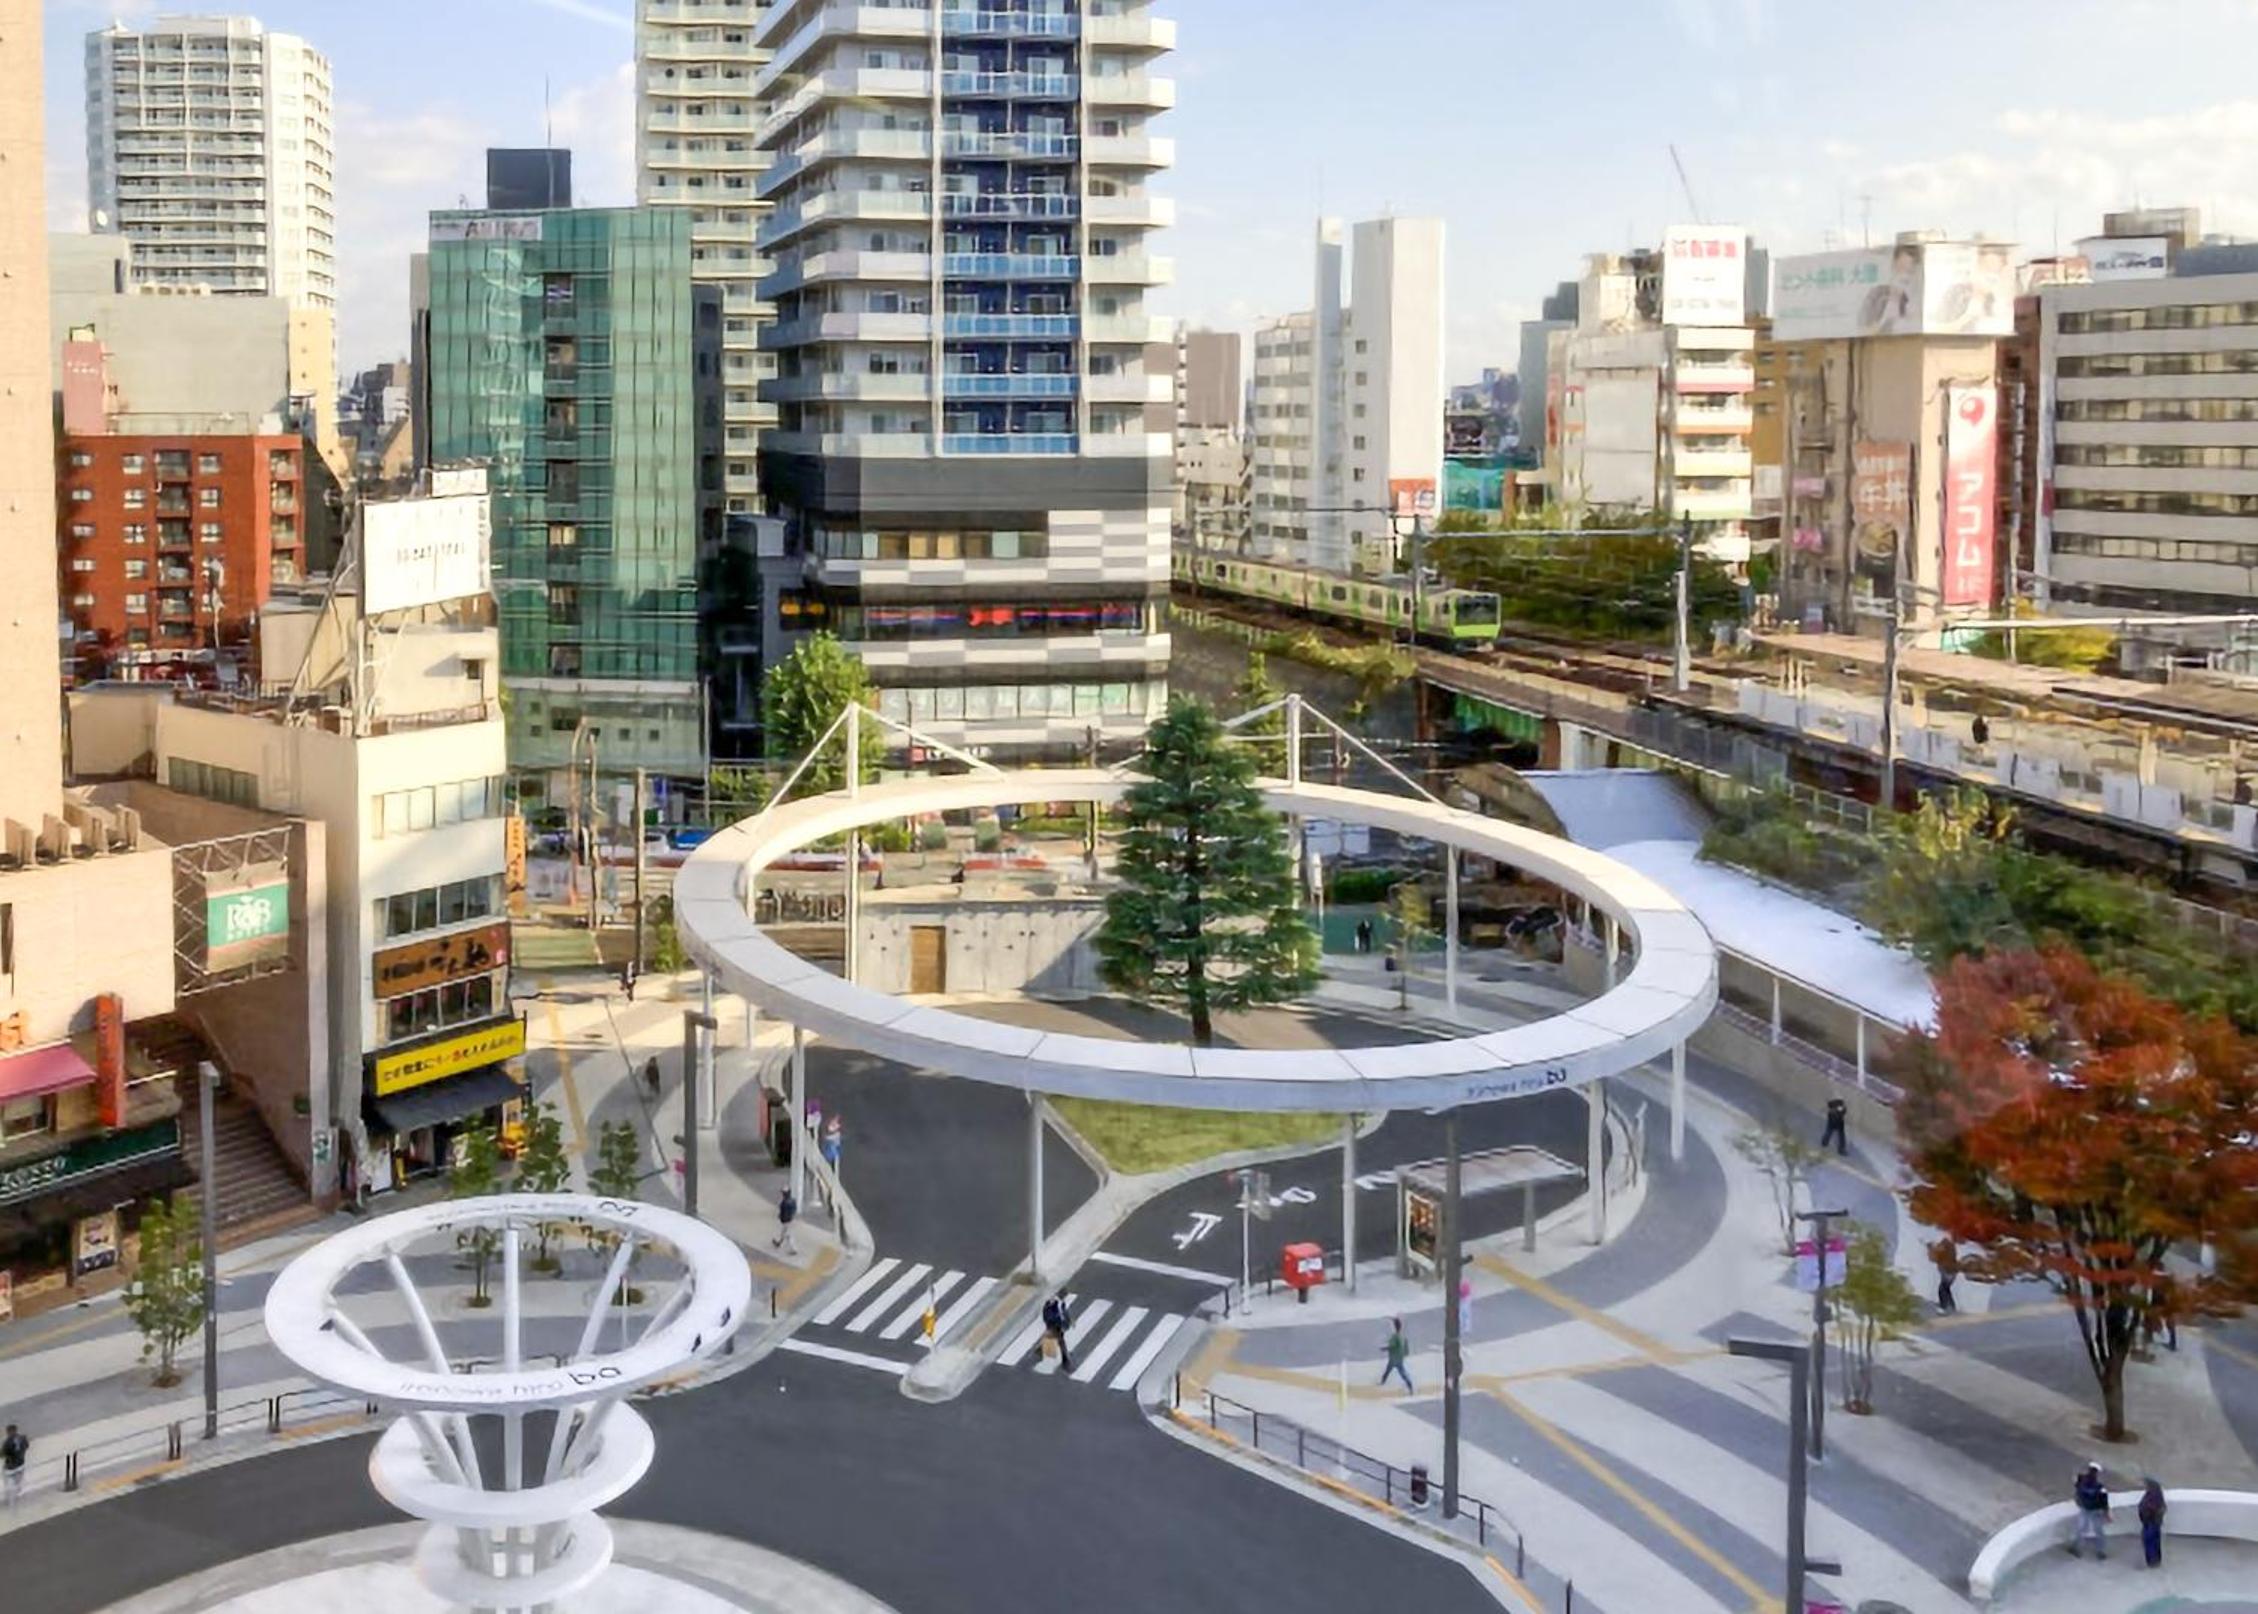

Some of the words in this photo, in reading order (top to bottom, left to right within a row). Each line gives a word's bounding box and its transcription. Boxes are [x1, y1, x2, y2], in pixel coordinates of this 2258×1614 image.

[1956, 472, 1983, 567] アコム
[569, 1366, 622, 1386] ba
